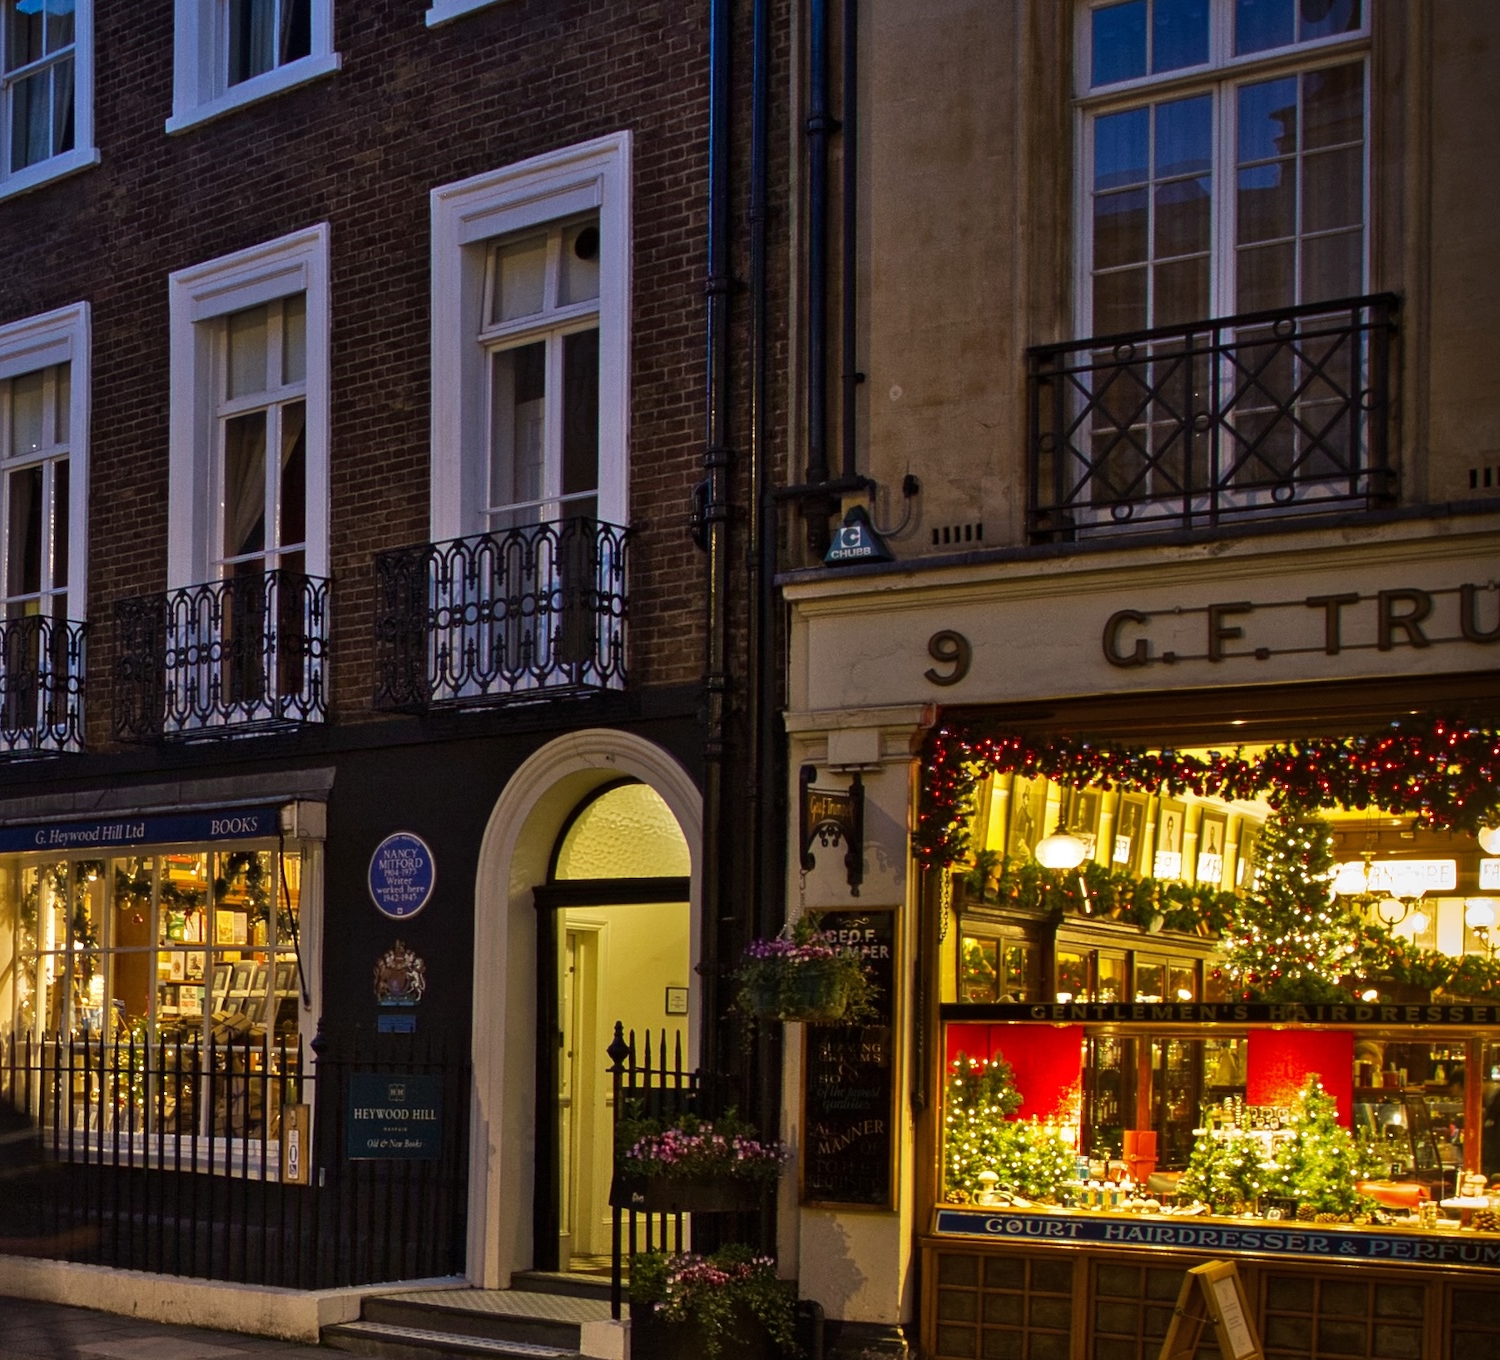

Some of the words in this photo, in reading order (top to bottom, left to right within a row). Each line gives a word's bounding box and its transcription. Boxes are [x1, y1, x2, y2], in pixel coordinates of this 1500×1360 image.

[831, 547, 871, 559] CHUBB
[924, 630, 972, 686] 9
[35, 830, 46, 845] G.
[49, 827, 100, 846] Heywood
[102, 824, 122, 840] Hill
[125, 822, 145, 838] Ltd
[210, 816, 258, 835] BOOKS
[383, 848, 418, 859] NANCY
[379, 857, 423, 870] MITFORD
[386, 877, 413, 885] Writer
[376, 885, 404, 894] worked
[407, 885, 425, 893] here
[383, 893, 417, 902] 1942-1945
[1030, 1005, 1248, 1020] GENTLEMEN'S
[354, 1108, 409, 1120] HEYWOOD
[412, 1109, 436, 1120] HILL
[818, 1119, 884, 1154] MANNER
[367, 1138, 379, 1148] Old
[380, 1139, 388, 1148] &
[389, 1139, 404, 1148] New
[404, 1138, 422, 1148] Books
[985, 1218, 1084, 1238] COURT
[1104, 1224, 1330, 1253] HAIRDRESSER
[1339, 1240, 1358, 1254] &
